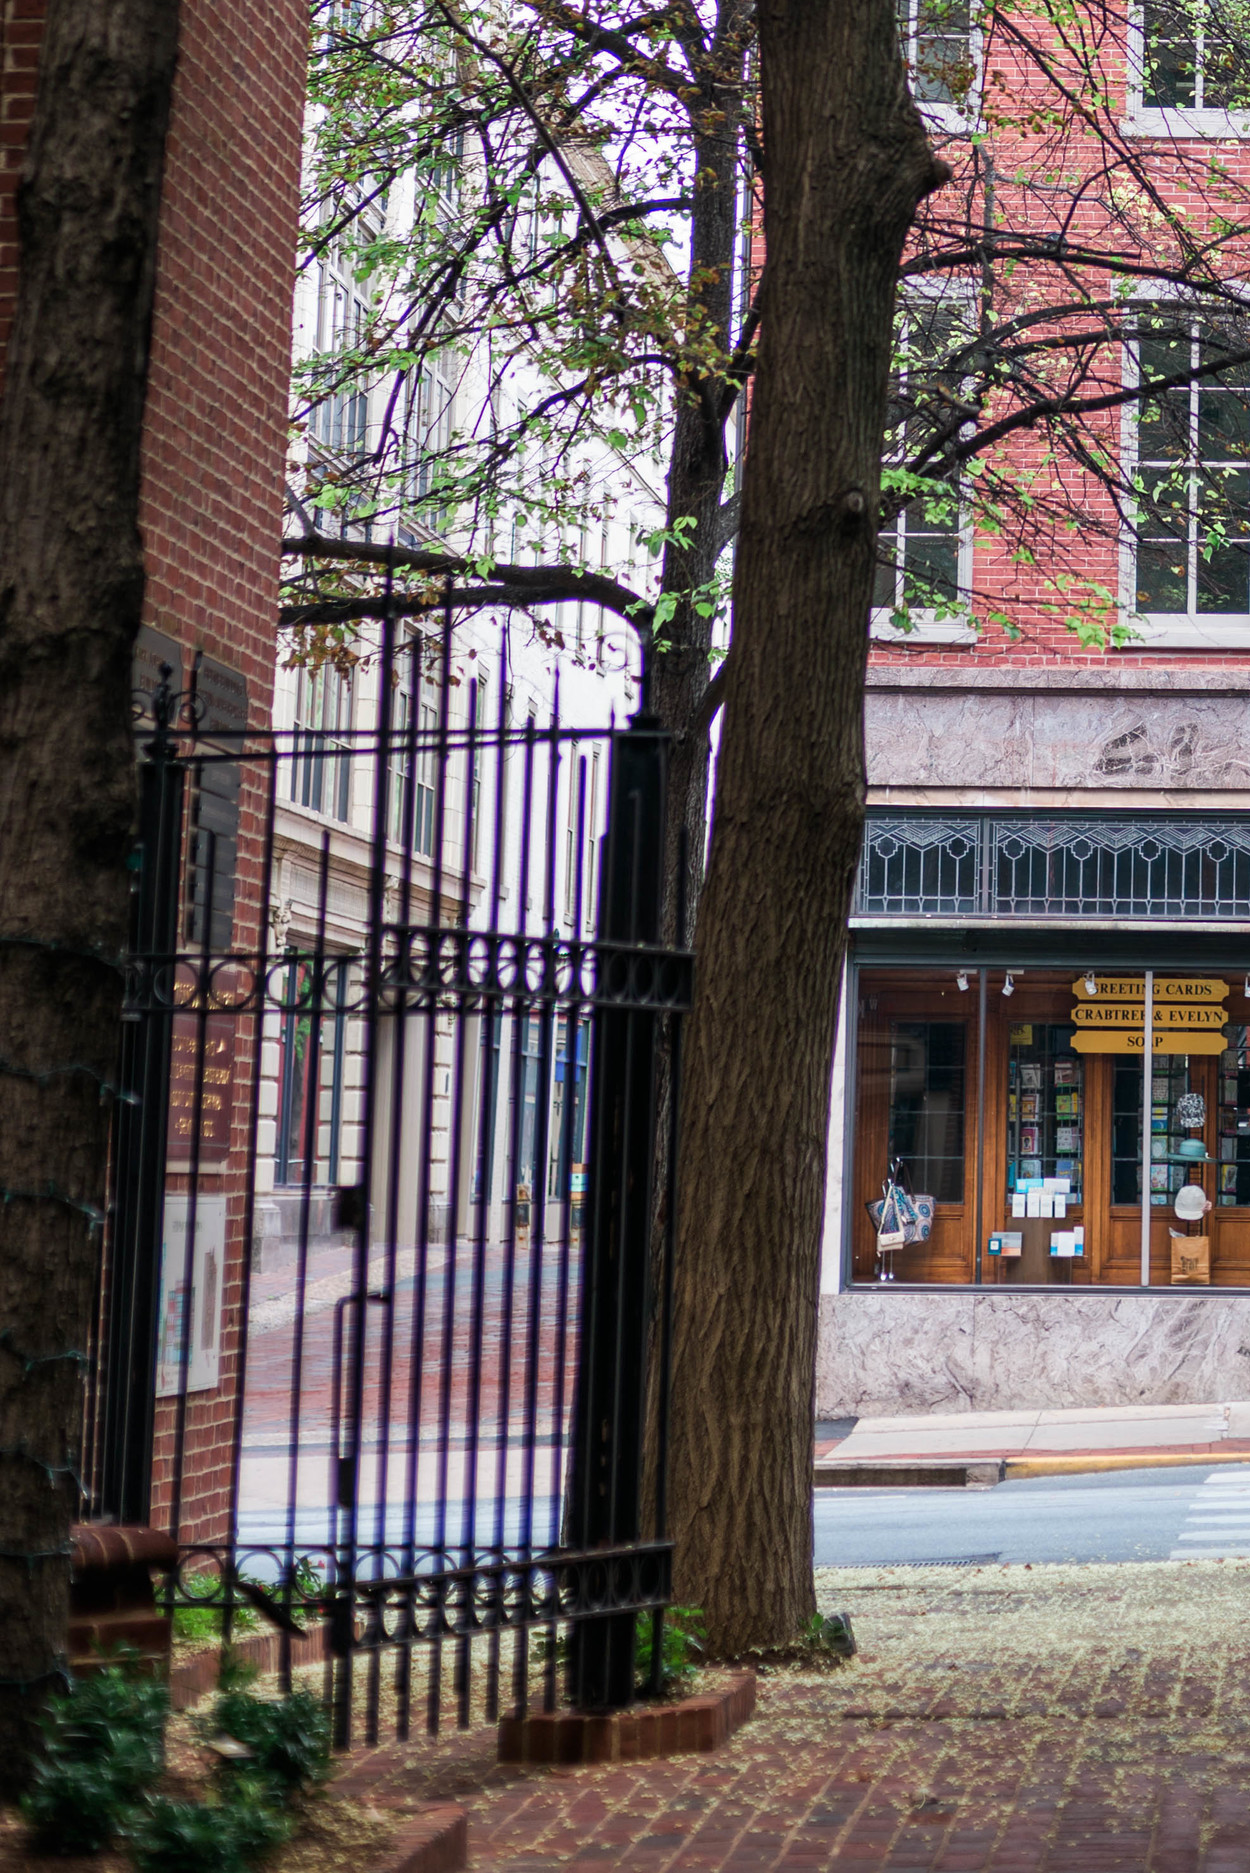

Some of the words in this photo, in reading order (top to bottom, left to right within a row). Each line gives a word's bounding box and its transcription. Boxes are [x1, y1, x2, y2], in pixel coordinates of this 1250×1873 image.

[1165, 983, 1212, 995] CARDS
[1154, 1010, 1163, 1021] &
[1169, 1010, 1223, 1022] EVELYN
[1127, 1036, 1163, 1047] SOP
